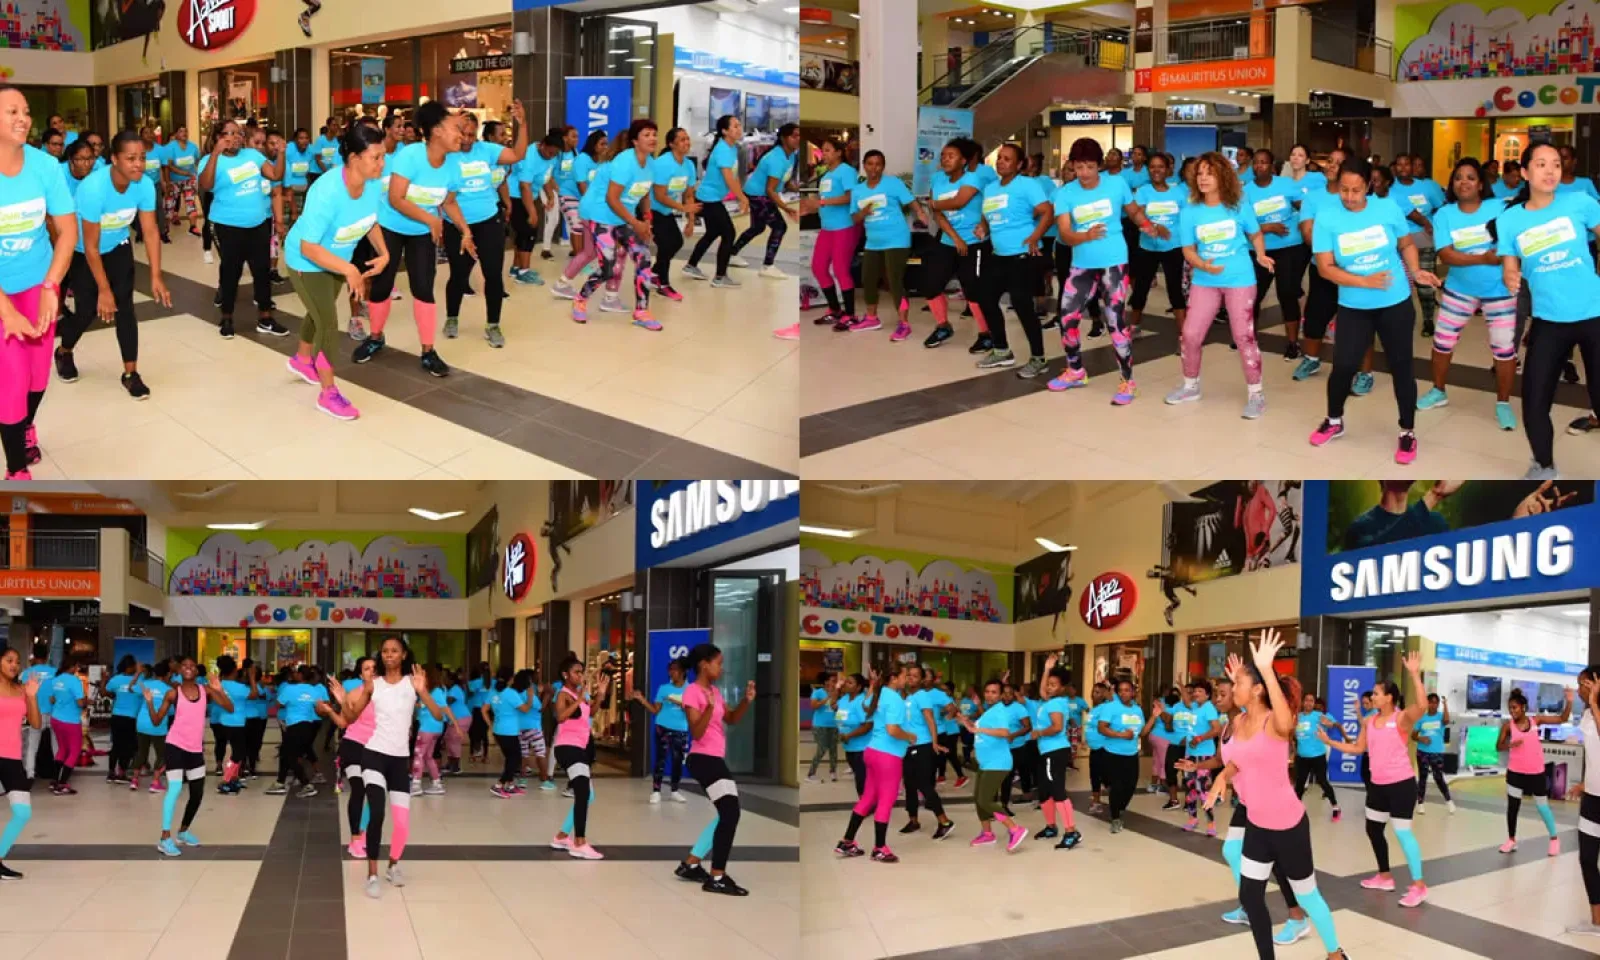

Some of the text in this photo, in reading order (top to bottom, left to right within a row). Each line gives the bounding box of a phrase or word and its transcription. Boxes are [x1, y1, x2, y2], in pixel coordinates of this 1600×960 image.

[1169, 67, 1267, 82] MAURITIUS UNION
[1330, 524, 1575, 602] SAMSUNG
[49, 579, 92, 590] UNION
